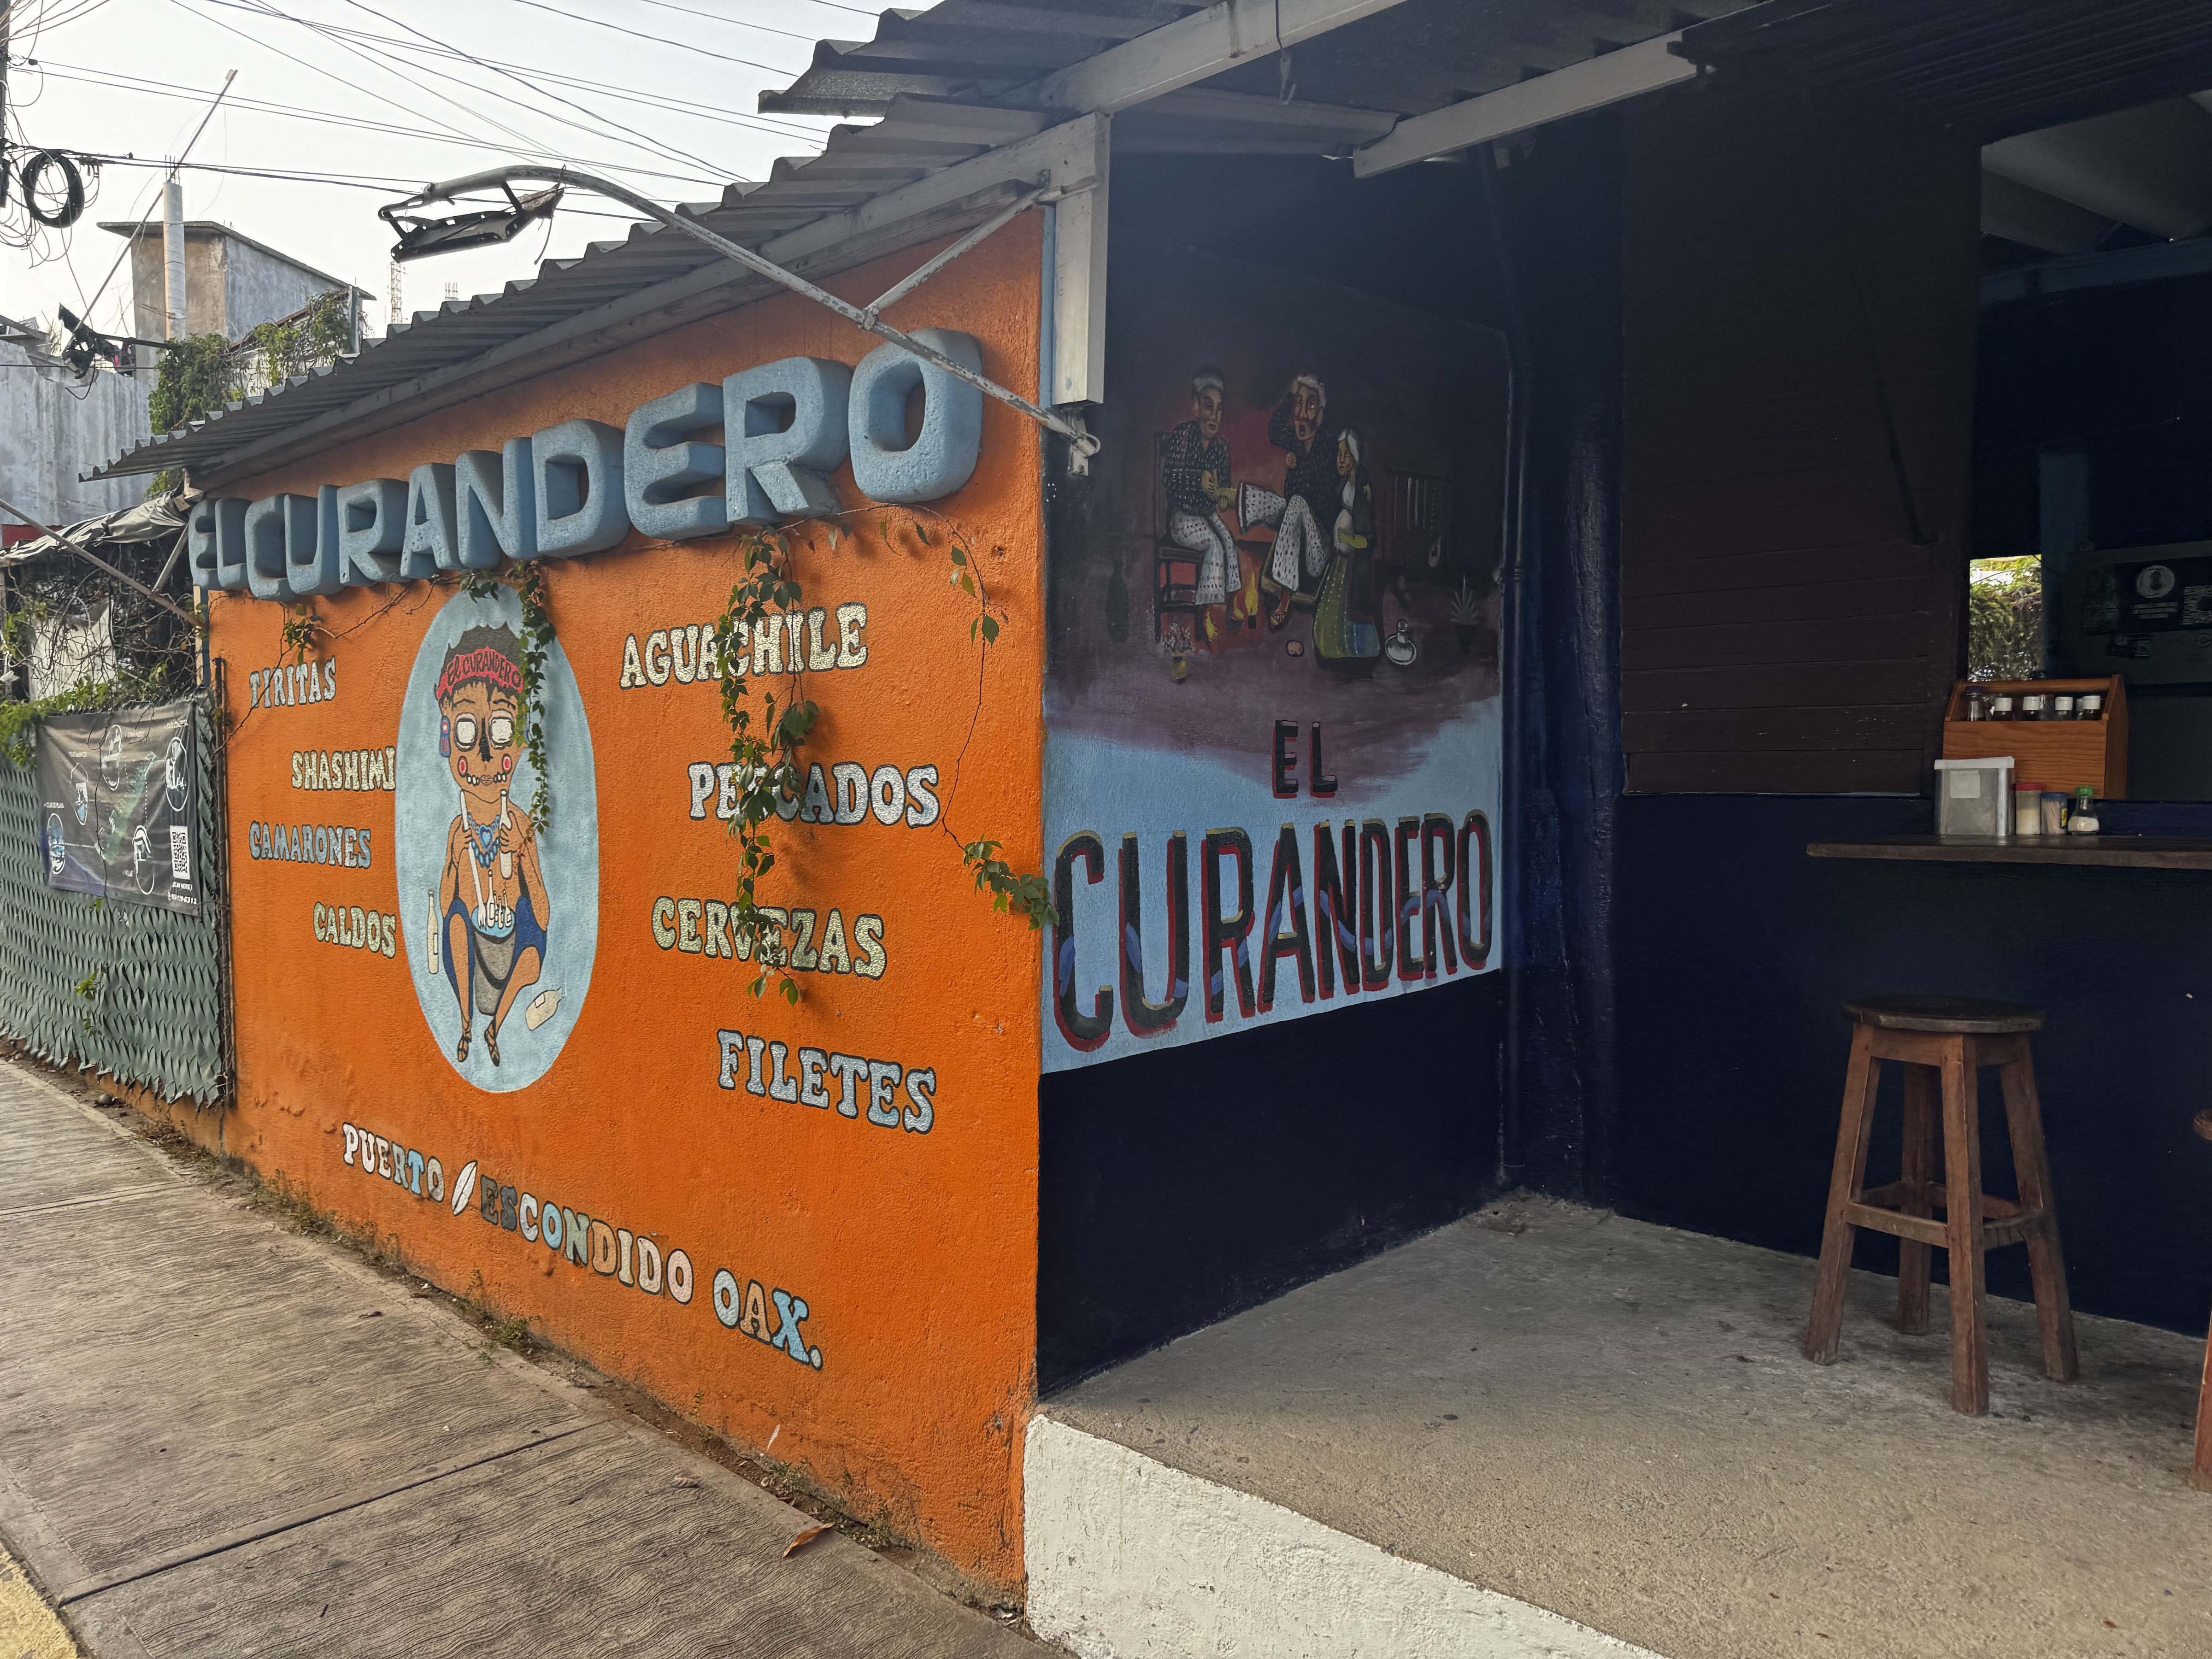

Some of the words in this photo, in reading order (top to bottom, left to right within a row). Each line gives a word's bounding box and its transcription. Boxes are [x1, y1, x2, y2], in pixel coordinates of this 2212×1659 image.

[188, 497, 252, 590] EL
[244, 328, 983, 601] CURANDERO
[249, 655, 336, 708] TIRITAS
[463, 651, 522, 688] CURANDERO
[291, 746, 396, 791] SHASHIMI
[1272, 720, 1338, 798] EL
[249, 821, 371, 869] CAMARONES
[313, 901, 396, 959] CALDOS
[652, 896, 887, 980] CERVEZAS
[1053, 809, 1493, 1052] CURANDERO
[717, 1028, 936, 1135] FILETES
[342, 1122, 445, 1203] PUERTO
[480, 1174, 694, 1305] ESCONDIDO
[712, 1268, 824, 1371] OAX.
